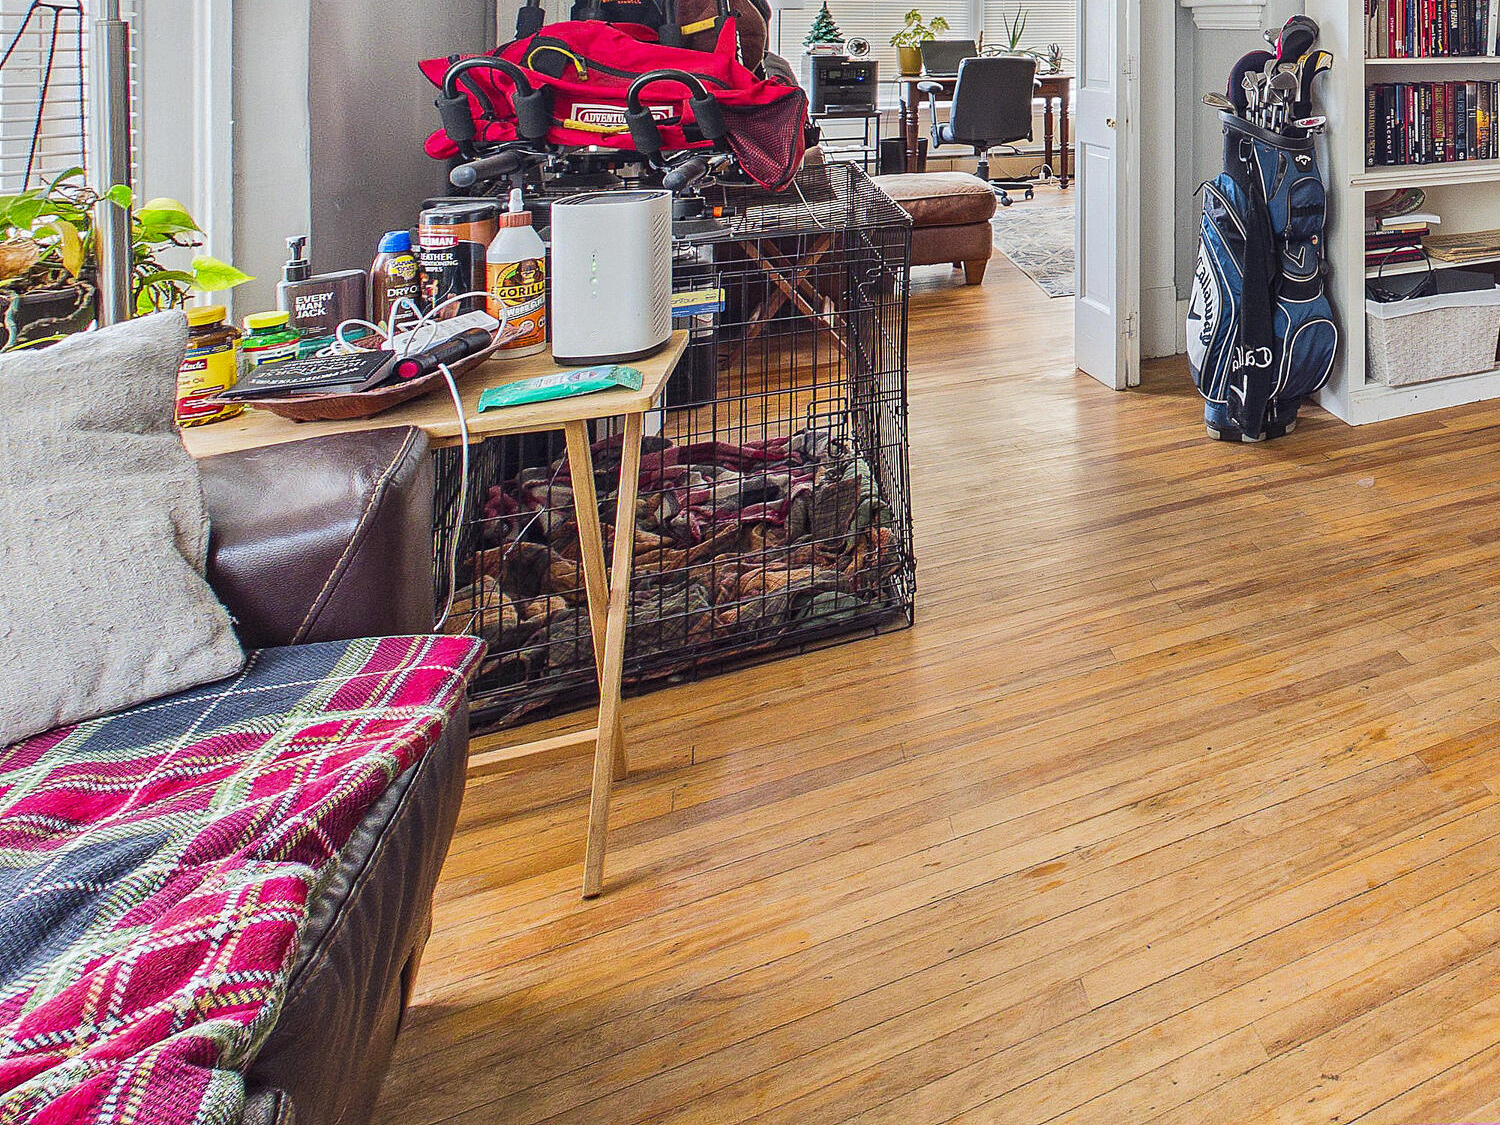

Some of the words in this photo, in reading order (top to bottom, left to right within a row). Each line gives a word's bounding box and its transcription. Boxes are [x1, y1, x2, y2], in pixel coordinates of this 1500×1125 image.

[295, 291, 335, 305] EVERY
[295, 300, 323, 311] MAN
[296, 307, 329, 319] JACK
